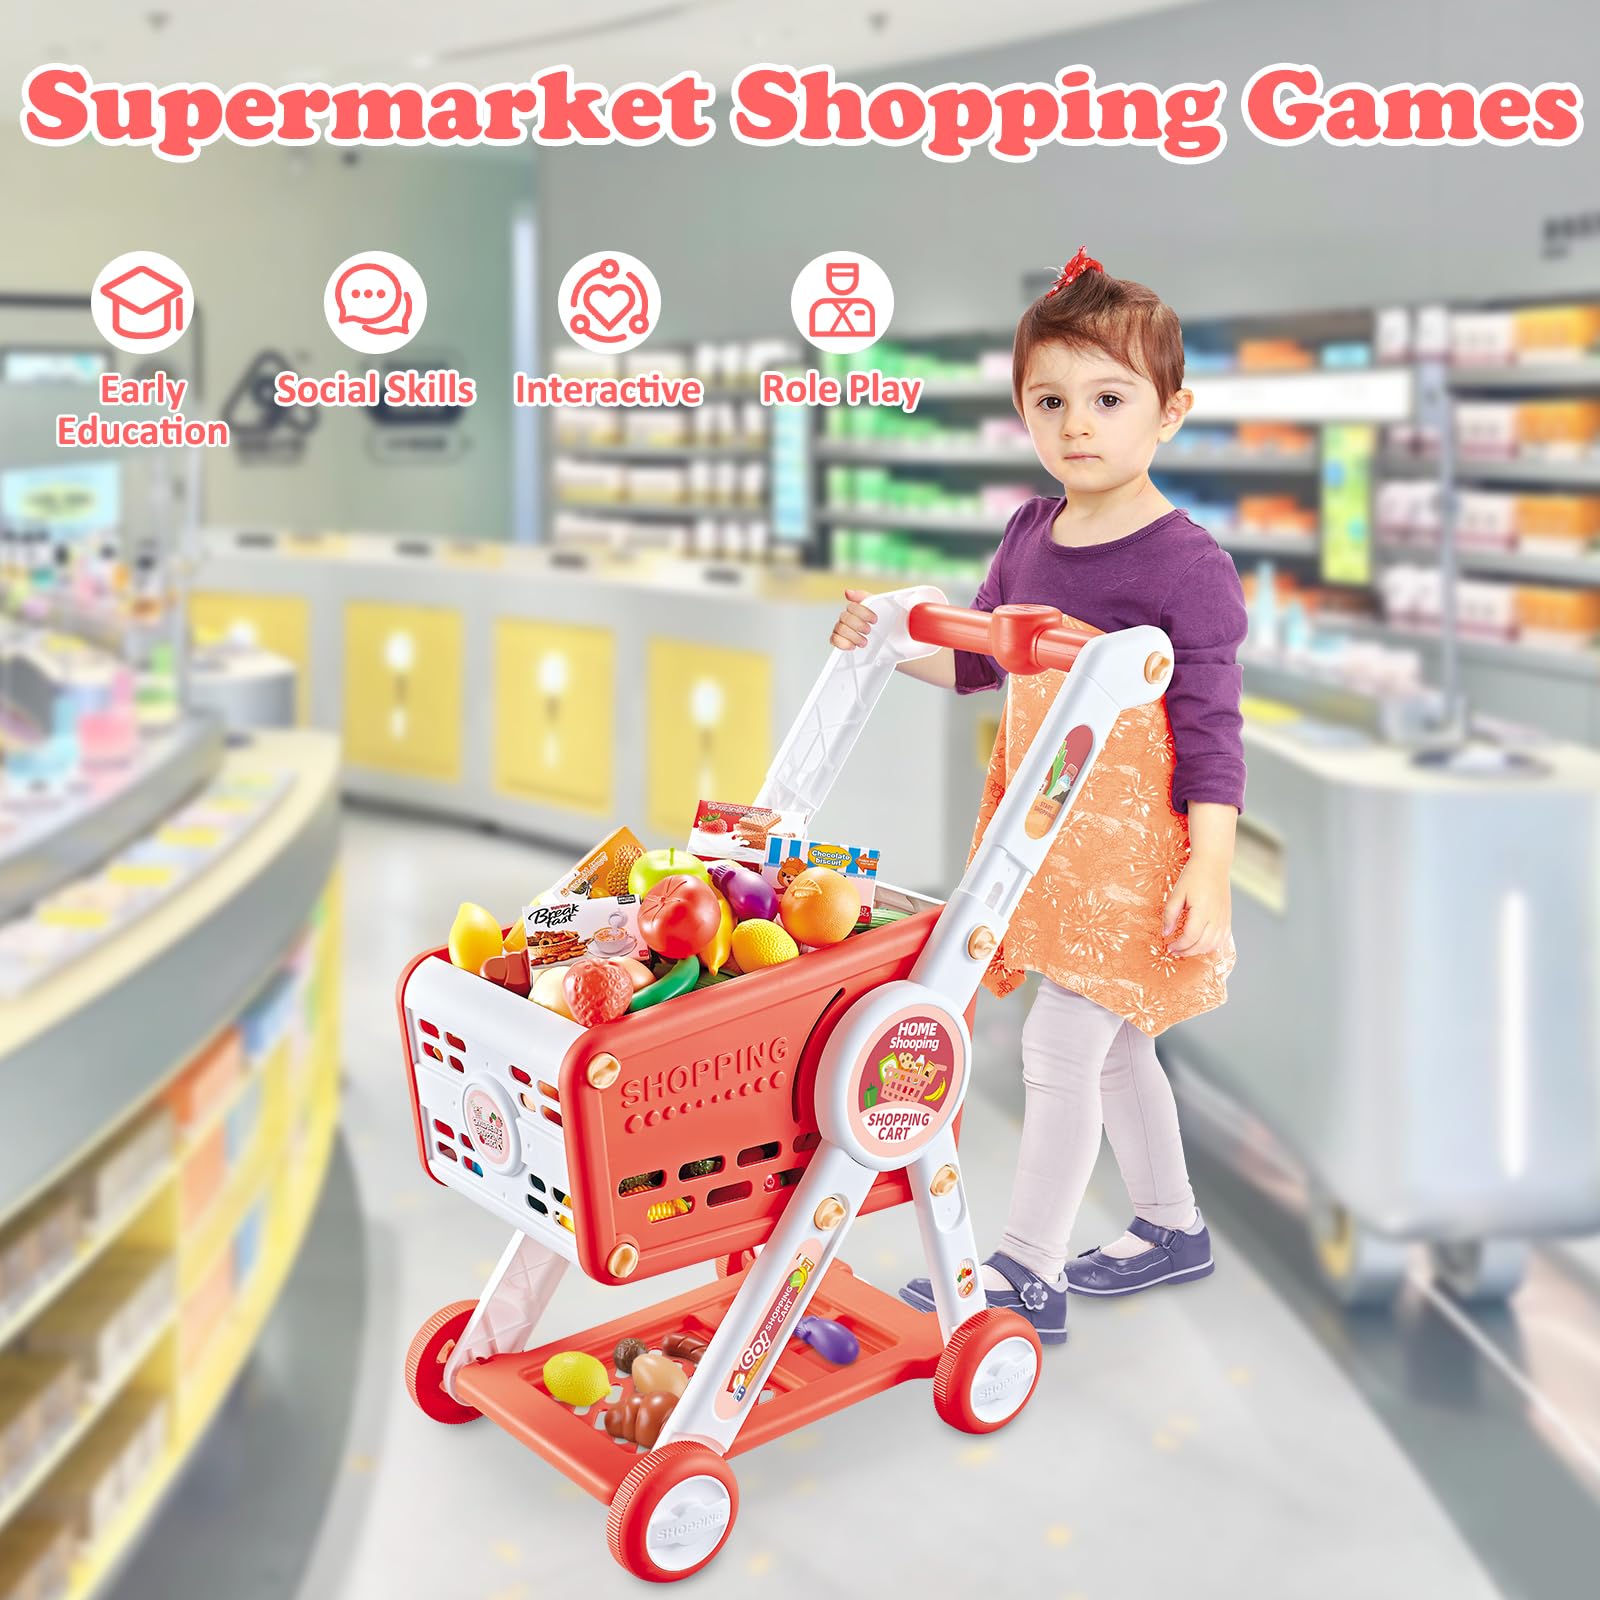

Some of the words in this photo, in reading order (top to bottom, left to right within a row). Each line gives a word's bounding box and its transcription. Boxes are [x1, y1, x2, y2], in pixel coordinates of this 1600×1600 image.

[811, 849, 851, 861] Chocolate
[815, 857, 842, 867] biscuit
[528, 903, 580, 925] Break
[897, 1022, 938, 1037] HOME
[889, 1036, 940, 1053] Shooping
[620, 1035, 789, 1109] SHOPPING
[867, 1112, 931, 1127] SHOPPING
[878, 1126, 911, 1141] CART
[777, 1298, 794, 1324] CART
[740, 1329, 772, 1370] GO!
[765, 1285, 794, 1332] SHOPPING
[656, 1511, 724, 1542] SHOPPING
